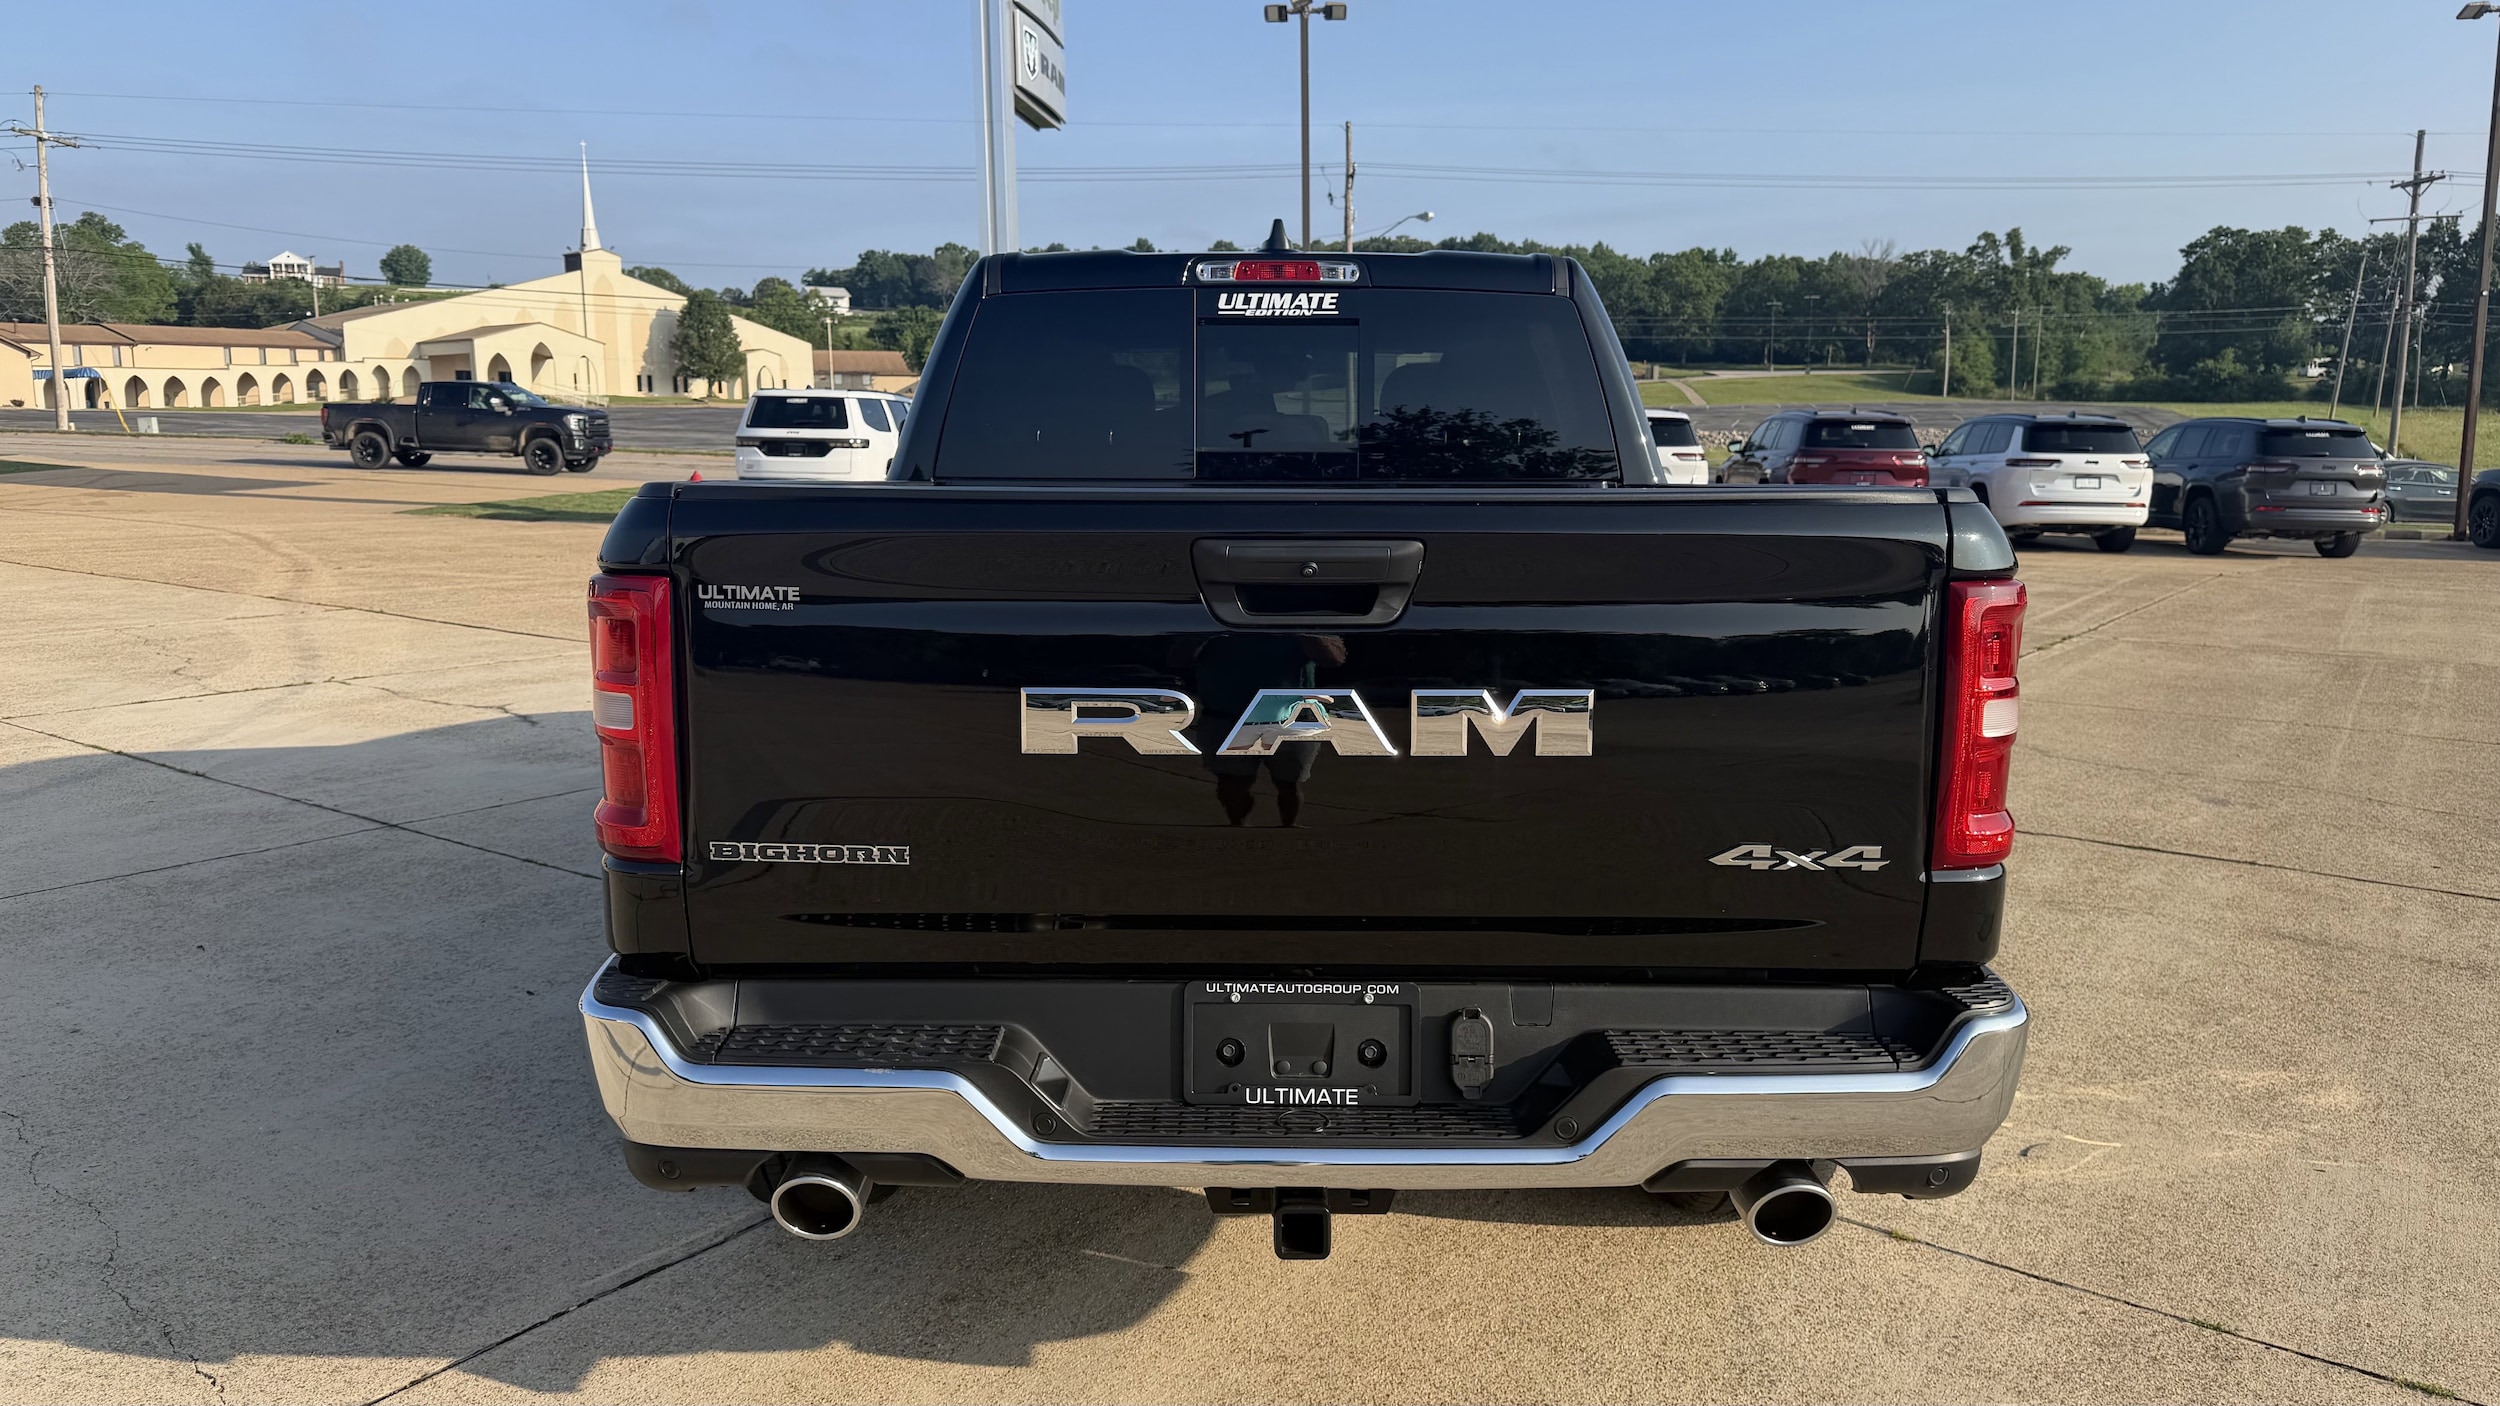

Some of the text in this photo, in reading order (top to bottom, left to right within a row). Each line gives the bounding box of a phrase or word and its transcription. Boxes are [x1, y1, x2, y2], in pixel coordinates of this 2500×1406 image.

[1218, 293, 1339, 309] ULTIMATE
[698, 584, 800, 601] ULTIMATE
[704, 601, 751, 609] MOUNTAIN
[752, 602, 780, 611] HOME,
[1020, 687, 1595, 757] RAM
[709, 842, 910, 865] BIGHORN
[1708, 844, 1890, 871] 4x4
[1206, 983, 1400, 994] ULTIMATEAUTOGROUP.COM
[1245, 1088, 1359, 1105] ULTIMATE
